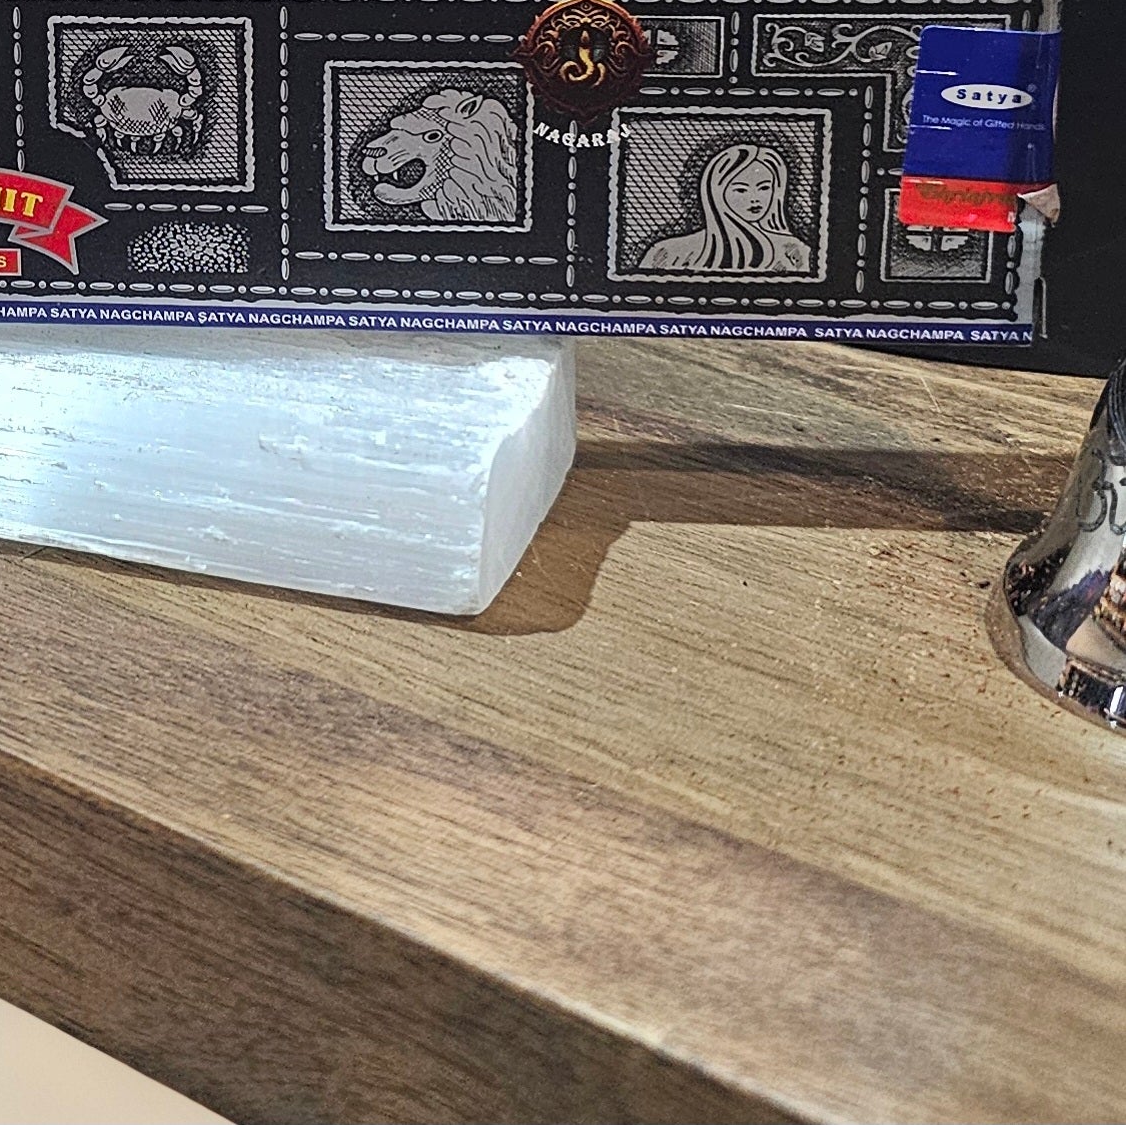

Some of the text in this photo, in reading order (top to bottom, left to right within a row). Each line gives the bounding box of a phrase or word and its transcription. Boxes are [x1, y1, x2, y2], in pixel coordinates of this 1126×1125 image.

[956, 88, 1022, 104] Satya
[923, 114, 940, 124] The
[941, 116, 971, 128] Magic
[973, 118, 984, 128] of
[51, 307, 97, 320] SATYA
[100, 309, 195, 322] NAGCHAMPA
[198, 311, 245, 324] SATYA
[249, 313, 345, 327] NAGCHAMPA
[349, 315, 397, 328] SATYA
[401, 317, 500, 331] NAGCHAMPA
[503, 319, 552, 332] SATYA
[556, 321, 656, 334] NAGCHAMPA
[660, 324, 707, 336] SATYA
[711, 323, 807, 337] NAGCHAMPA
[815, 327, 863, 339] SATYA
[866, 328, 964, 341] NAGCHAMPA
[971, 330, 1018, 341] SATYA
